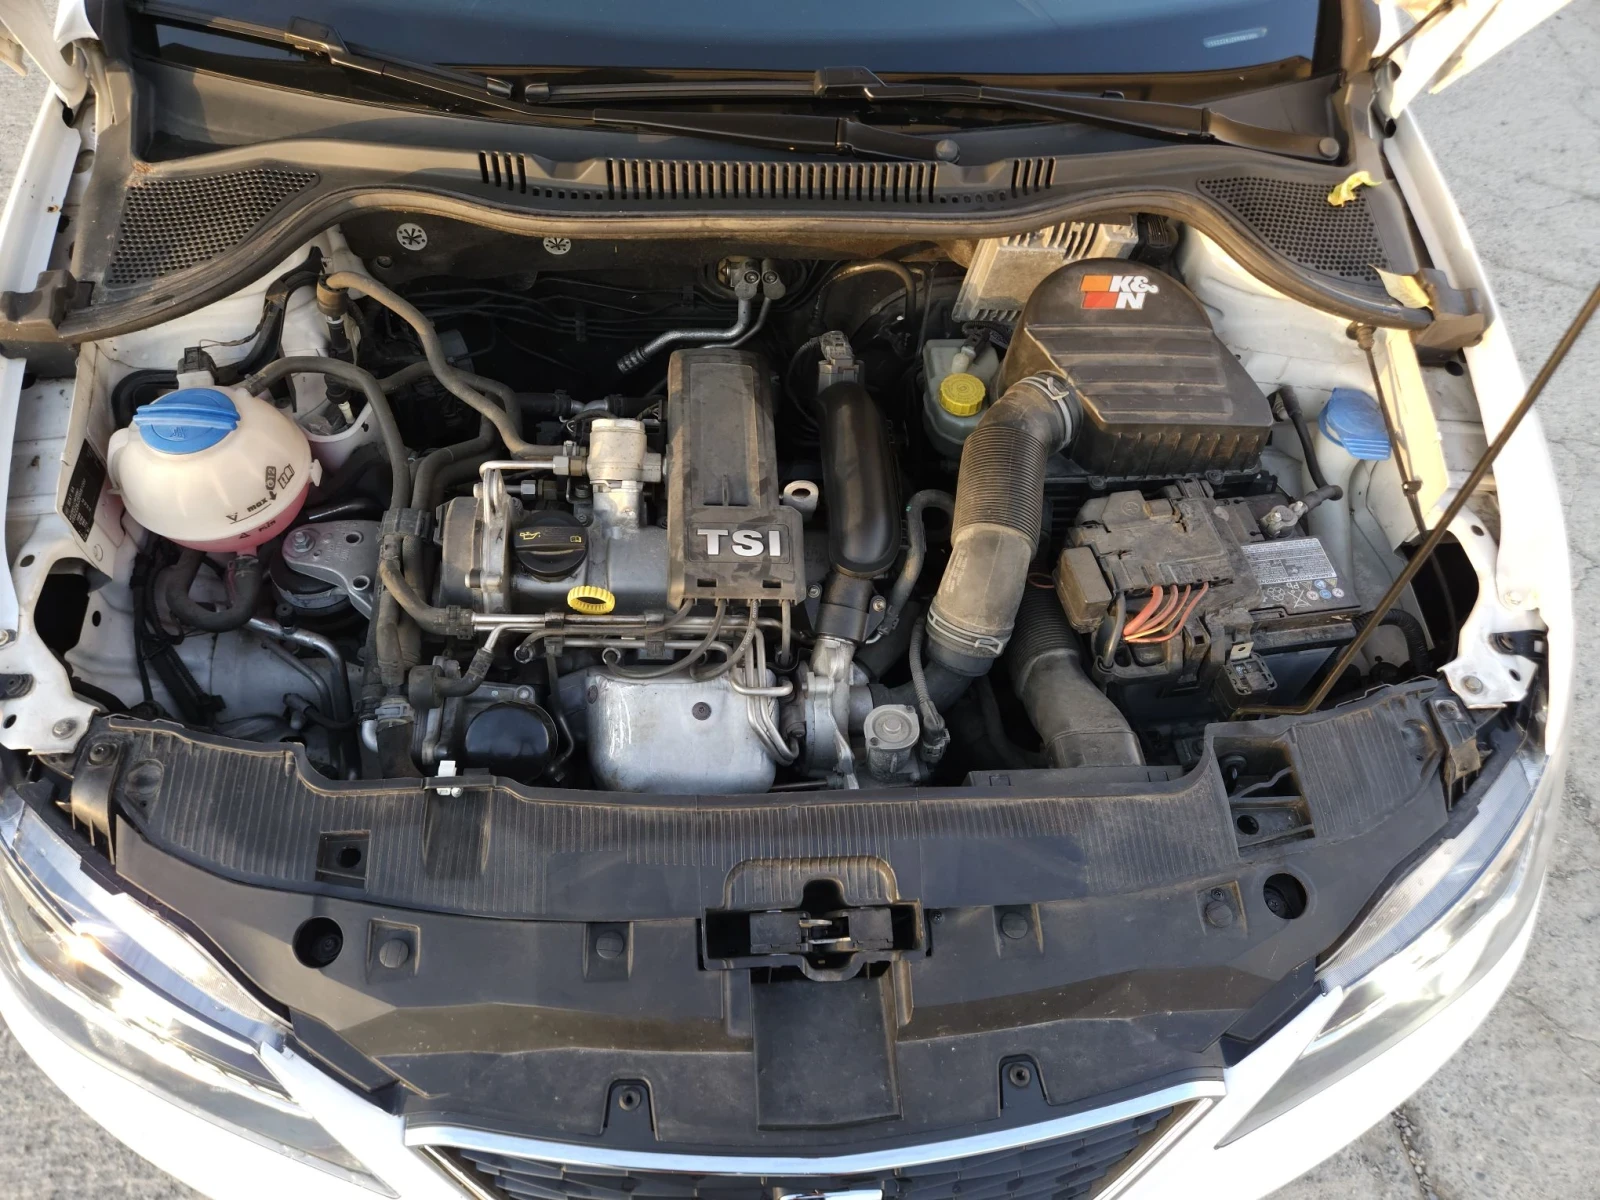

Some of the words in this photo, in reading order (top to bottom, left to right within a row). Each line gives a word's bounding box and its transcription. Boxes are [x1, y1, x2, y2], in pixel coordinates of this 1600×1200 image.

[1115, 292, 1146, 309] N
[247, 498, 268, 513] max
[697, 528, 781, 557] TSI
[1286, 582, 1300, 590] Pb
